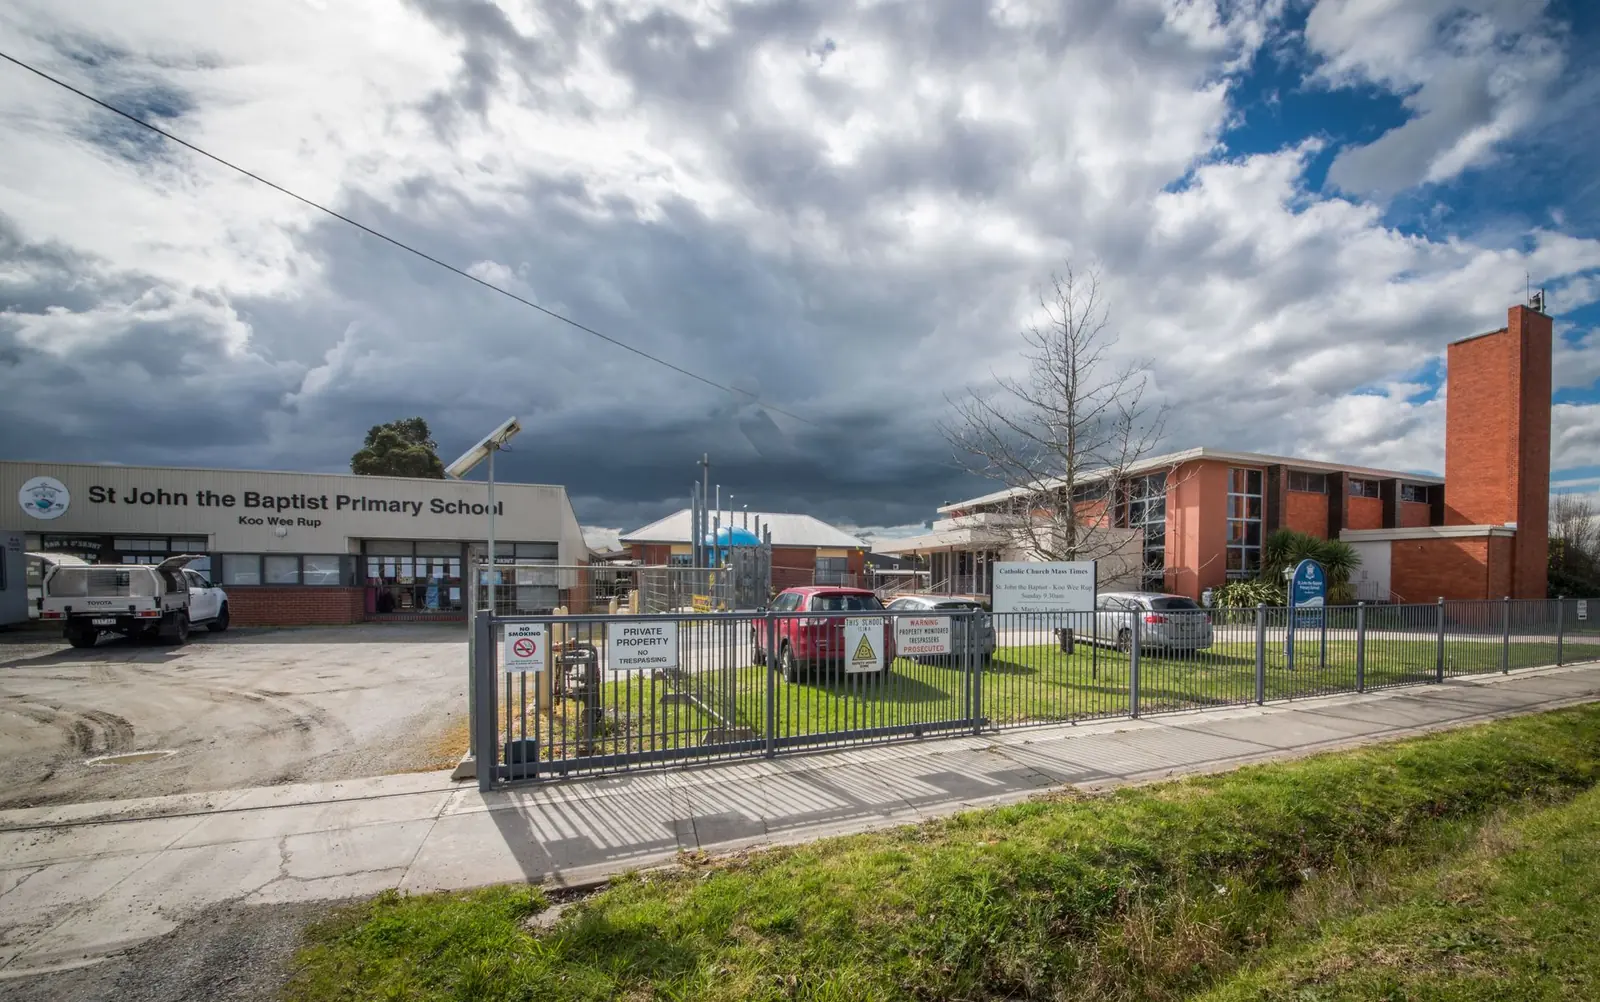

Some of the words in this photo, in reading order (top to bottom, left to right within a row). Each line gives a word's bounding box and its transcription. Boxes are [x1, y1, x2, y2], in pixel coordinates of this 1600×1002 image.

[88, 486, 116, 504] St
[124, 487, 188, 506] John
[196, 490, 236, 507] the
[244, 491, 328, 512] Baptist
[336, 495, 422, 516] Primary
[430, 498, 504, 516] School
[238, 516, 264, 526] Koo
[268, 516, 294, 526] Wee
[297, 518, 322, 528] Rup
[616, 638, 668, 646] PROPERTY
